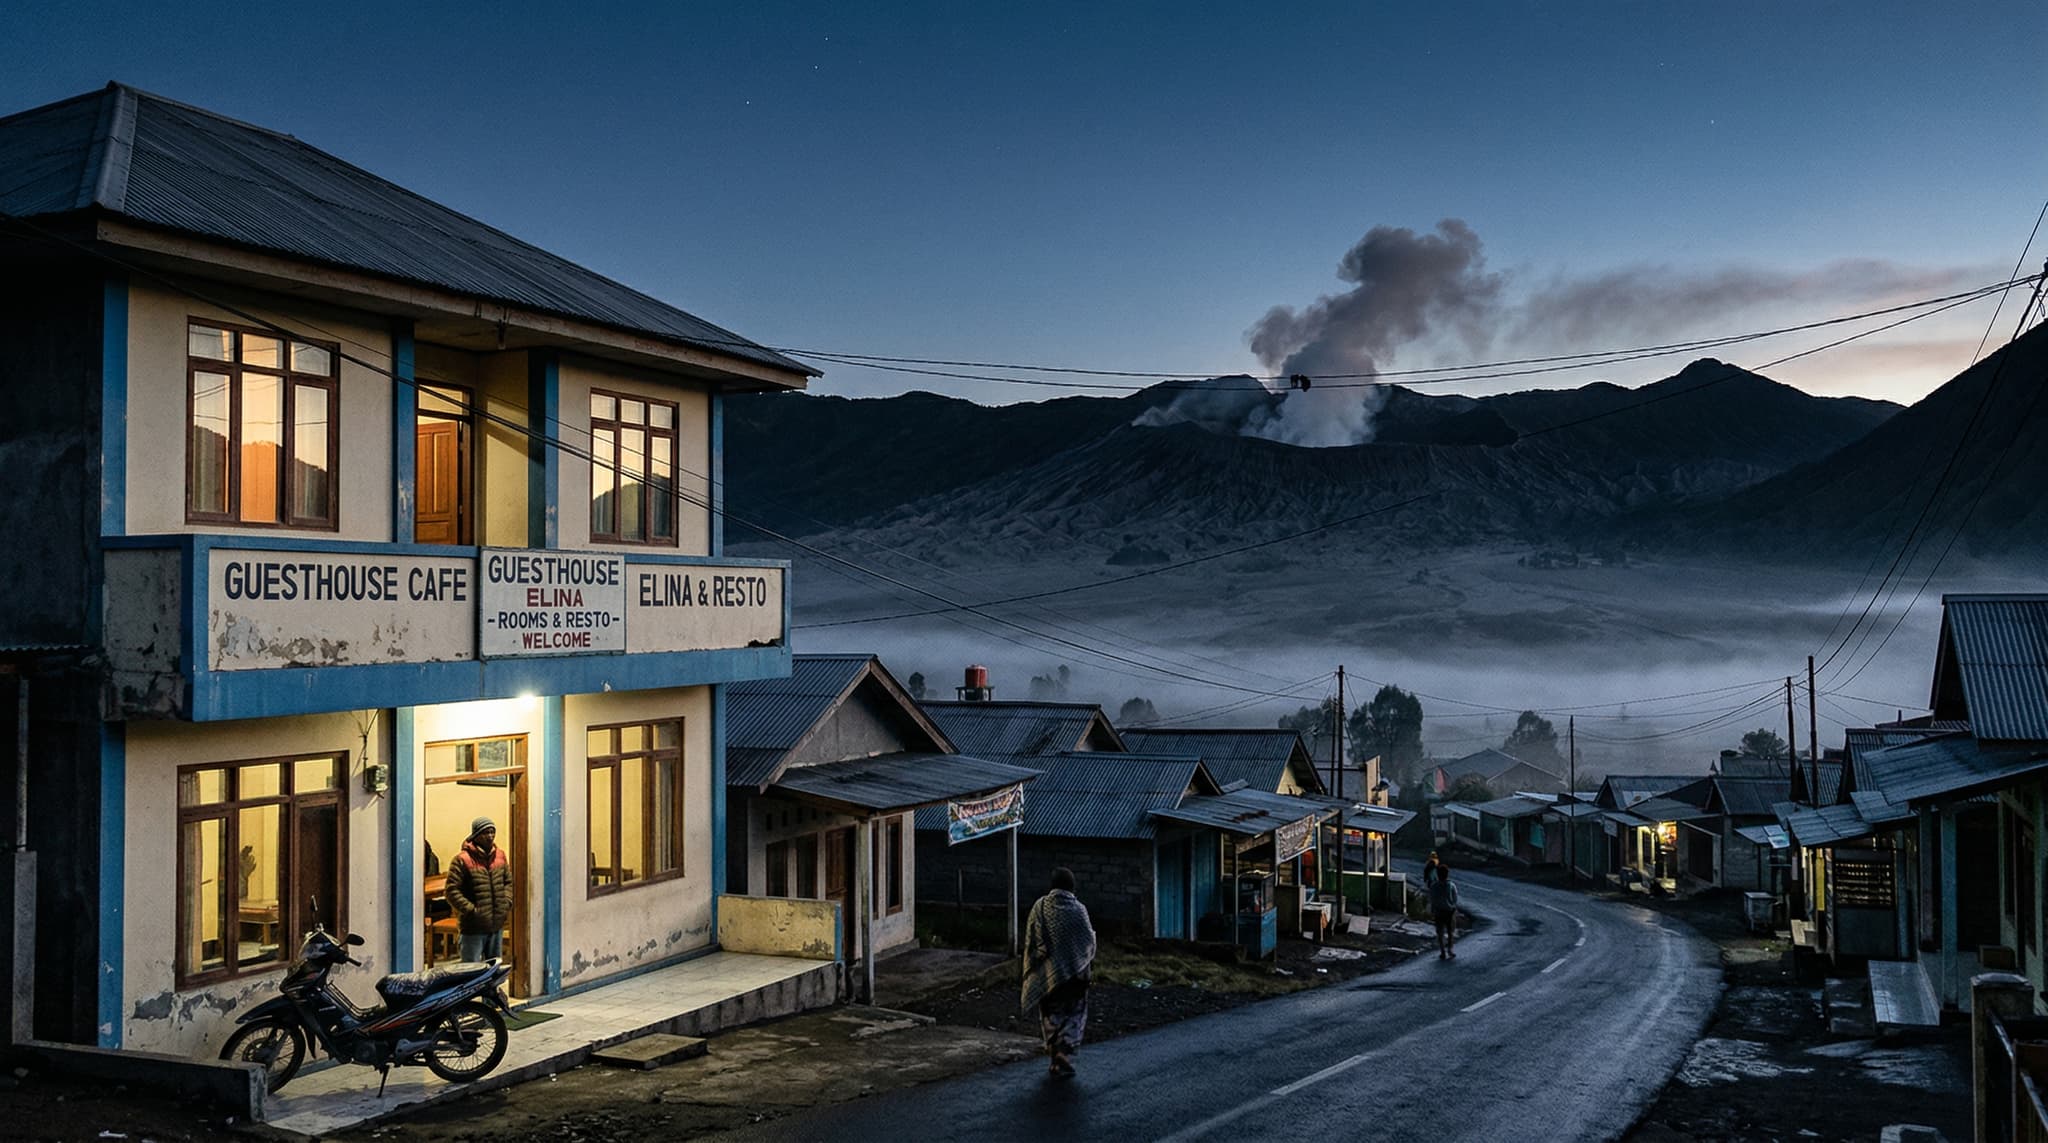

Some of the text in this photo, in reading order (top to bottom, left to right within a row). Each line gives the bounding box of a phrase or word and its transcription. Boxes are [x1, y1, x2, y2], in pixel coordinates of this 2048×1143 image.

[225, 562, 467, 601] GUESTHOUSE CAFE
[488, 555, 619, 586] GUESTHOUSE
[526, 588, 584, 607] ELINA
[639, 573, 767, 607] ELINA & RESTO
[552, 612, 562, 628] &
[522, 632, 591, 649] WELCOME
